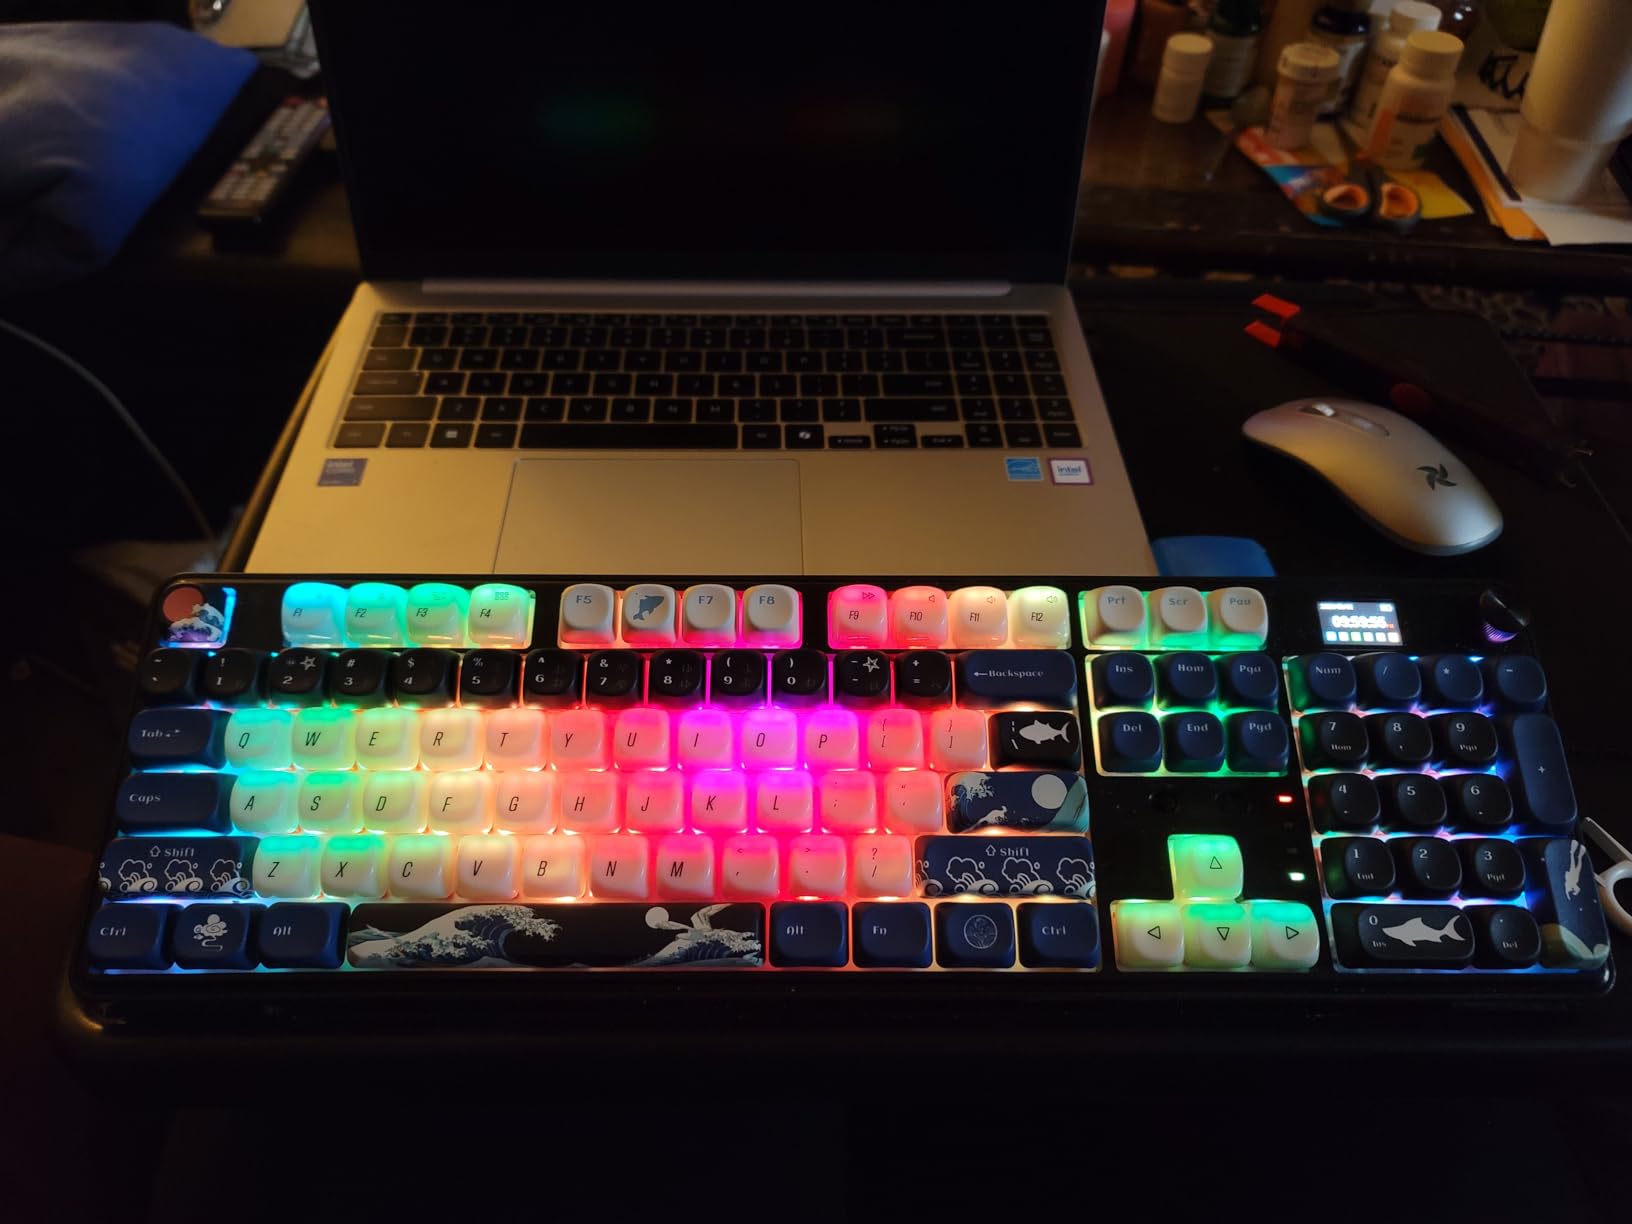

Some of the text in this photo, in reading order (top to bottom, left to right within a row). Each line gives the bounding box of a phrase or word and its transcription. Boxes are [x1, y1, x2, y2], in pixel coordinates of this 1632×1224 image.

[576, 595, 592, 604] F5
[698, 595, 714, 605] F7
[759, 596, 775, 605] F8
[1107, 596, 1126, 605] Prt
[1169, 598, 1188, 606] Scr
[1230, 598, 1250, 606] Pau
[355, 608, 366, 618] F2
[416, 608, 429, 618] F3
[479, 609, 491, 618] F4
[849, 611, 859, 620] F9
[909, 611, 923, 621] F10
[969, 612, 980, 621] F11
[1031, 612, 1043, 621] F12
[407, 658, 415, 668] $
[473, 657, 483, 666] %
[600, 659, 608, 668] &
[1115, 665, 1133, 673] Ins
[1178, 664, 1204, 672] Hom
[1315, 666, 1341, 674] Num
[535, 674, 545, 683] 6
[988, 669, 1044, 679] Backspace
[216, 676, 222, 686] 1
[283, 676, 293, 685] 2
[344, 677, 353, 686] 3
[404, 676, 412, 685] 4
[472, 676, 481, 685] 5
[599, 676, 608, 686] 7
[663, 676, 672, 685] 8
[723, 676, 733, 685] 9
[787, 676, 796, 685] 0
[1123, 724, 1142, 732] Del
[1187, 723, 1208, 732] End
[1328, 722, 1336, 731] 7
[1393, 722, 1402, 731] 8
[1456, 723, 1465, 732] 9
[141, 728, 163, 737] Tab
[238, 732, 250, 749] Q
[305, 732, 322, 746] W
[369, 731, 379, 746] E
[433, 732, 444, 746] R
[500, 733, 509, 746] T
[564, 734, 573, 747] Y
[627, 733, 637, 747] U
[756, 733, 765, 748] O
[819, 734, 828, 749] P
[1339, 784, 1347, 794] 4
[1407, 786, 1416, 796] 5
[1471, 786, 1480, 795] 6
[129, 793, 161, 804] Caps
[244, 796, 255, 811] A
[310, 796, 322, 811] S
[376, 796, 387, 811] D
[706, 796, 716, 811] K
[773, 795, 779, 811] L
[442, 797, 452, 812] F
[509, 797, 519, 812] G
[574, 797, 584, 811] H
[641, 797, 650, 812] J
[164, 847, 195, 857] Shift
[1000, 845, 1030, 857] Shift
[1354, 849, 1359, 859] 1
[1419, 849, 1428, 859] 2
[1484, 851, 1493, 861] 3
[268, 862, 280, 878] Z
[335, 862, 348, 878] X
[402, 862, 413, 878] C
[473, 861, 483, 876] V
[537, 861, 548, 876] B
[606, 861, 617, 877] N
[670, 861, 685, 877] M
[1369, 915, 1378, 926] 0
[100, 927, 126, 936] Ctrl
[873, 926, 887, 937] Fn
[1042, 925, 1066, 936] Ctrl
